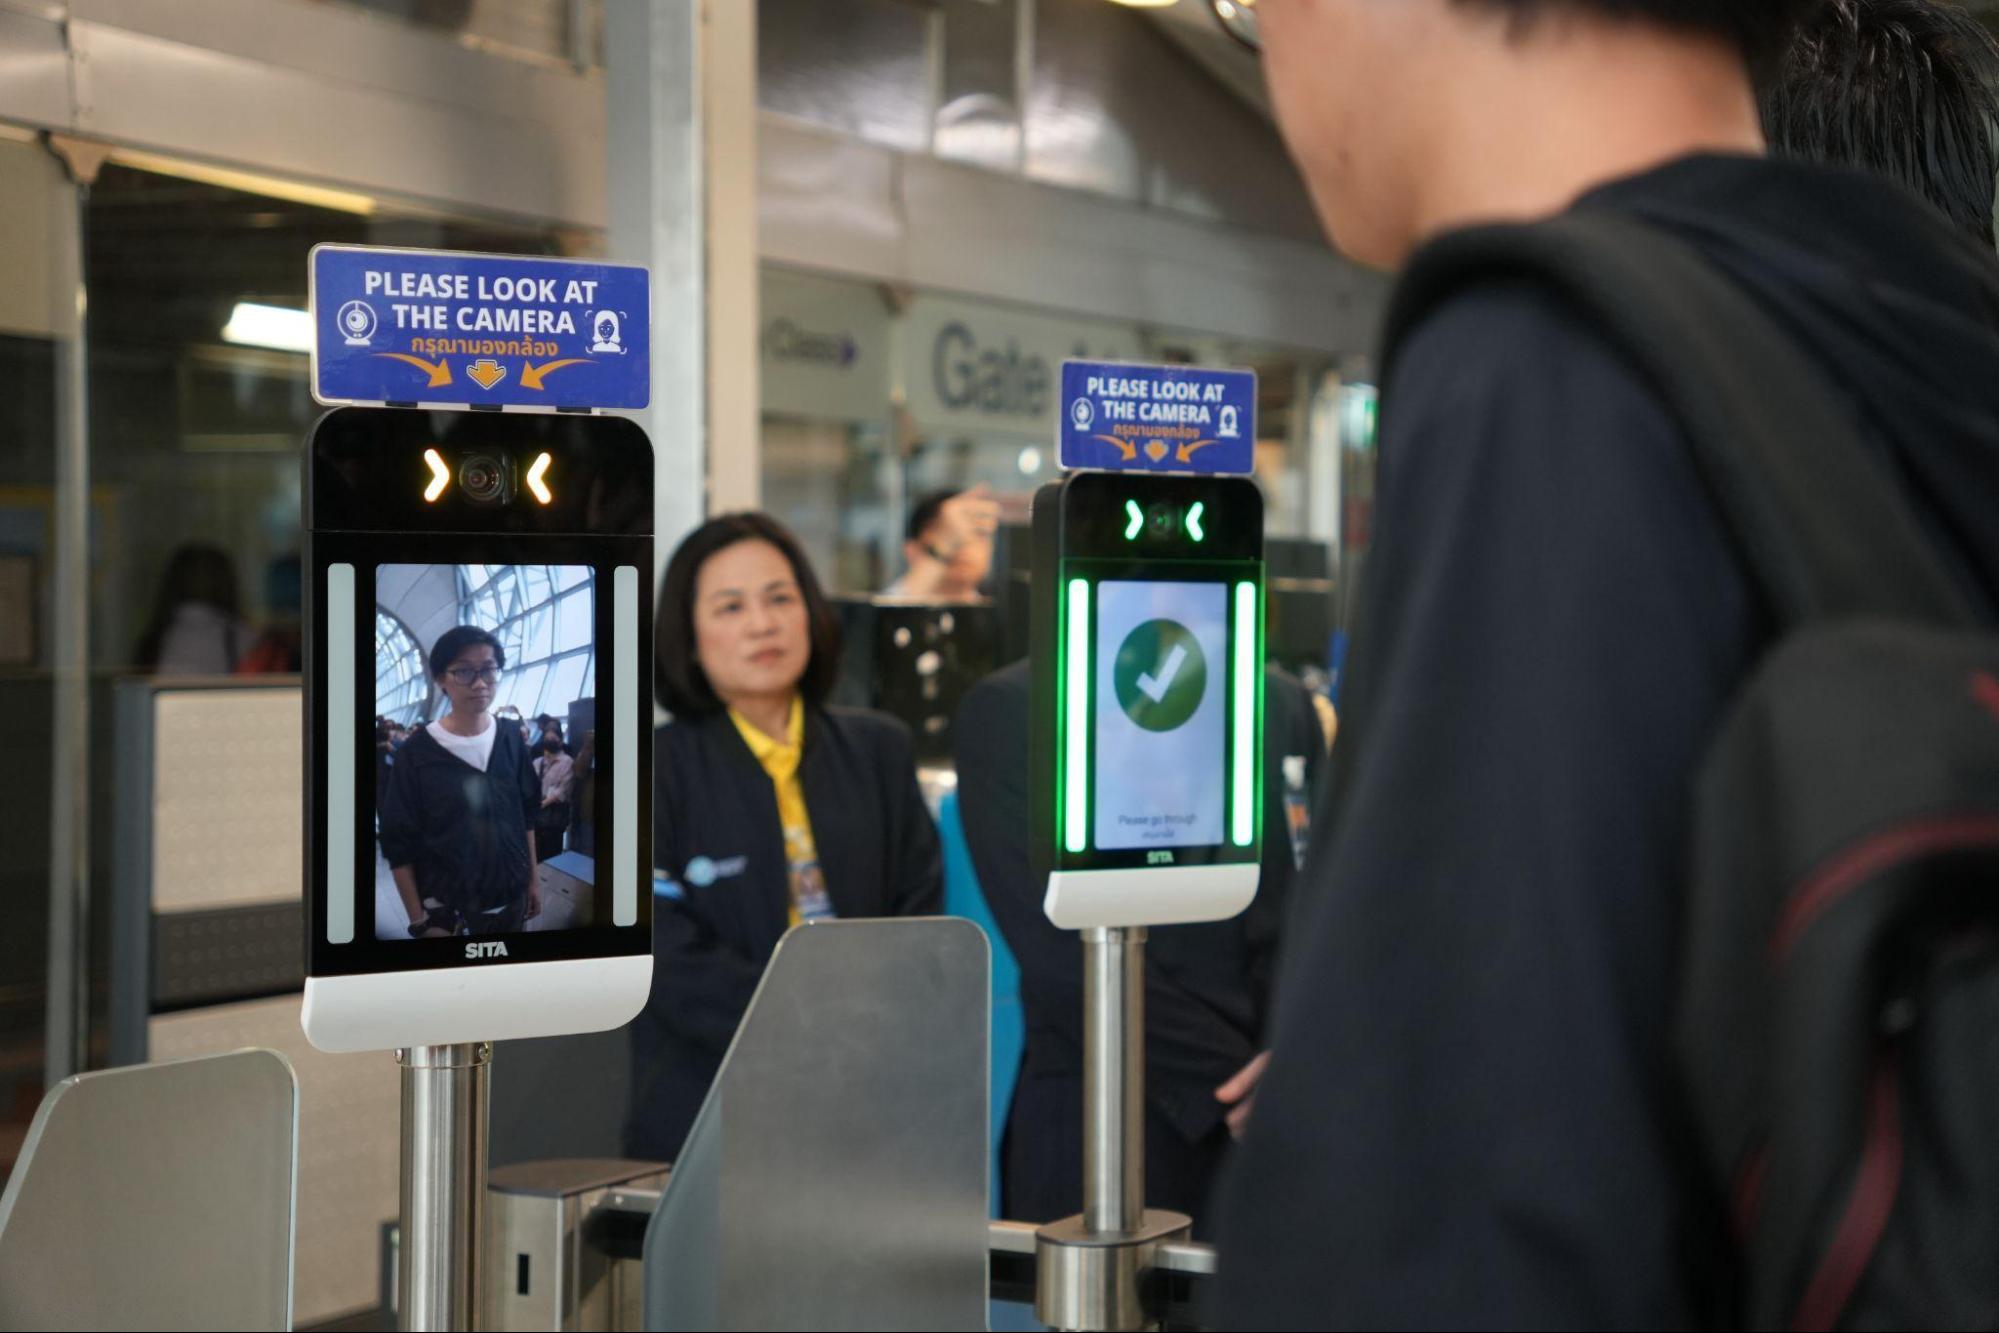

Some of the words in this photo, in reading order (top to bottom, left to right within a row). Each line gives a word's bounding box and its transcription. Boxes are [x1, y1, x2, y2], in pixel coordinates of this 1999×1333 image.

[365, 271, 469, 299] PLEASE
[478, 276, 557, 303] LOOK
[563, 280, 598, 304] AT
[392, 304, 448, 330] THE
[456, 308, 576, 334] CAMERA
[411, 335, 559, 358] กรุณามองกล้อง
[932, 320, 1051, 417] Gate
[1087, 376, 1148, 398] PLEASE
[1152, 381, 1200, 401] LOOK
[1203, 384, 1225, 402] AT
[1102, 400, 1136, 420] THE
[1139, 403, 1211, 424] CAMERA
[1147, 850, 1174, 865] SITA
[465, 941, 509, 959] SITA
